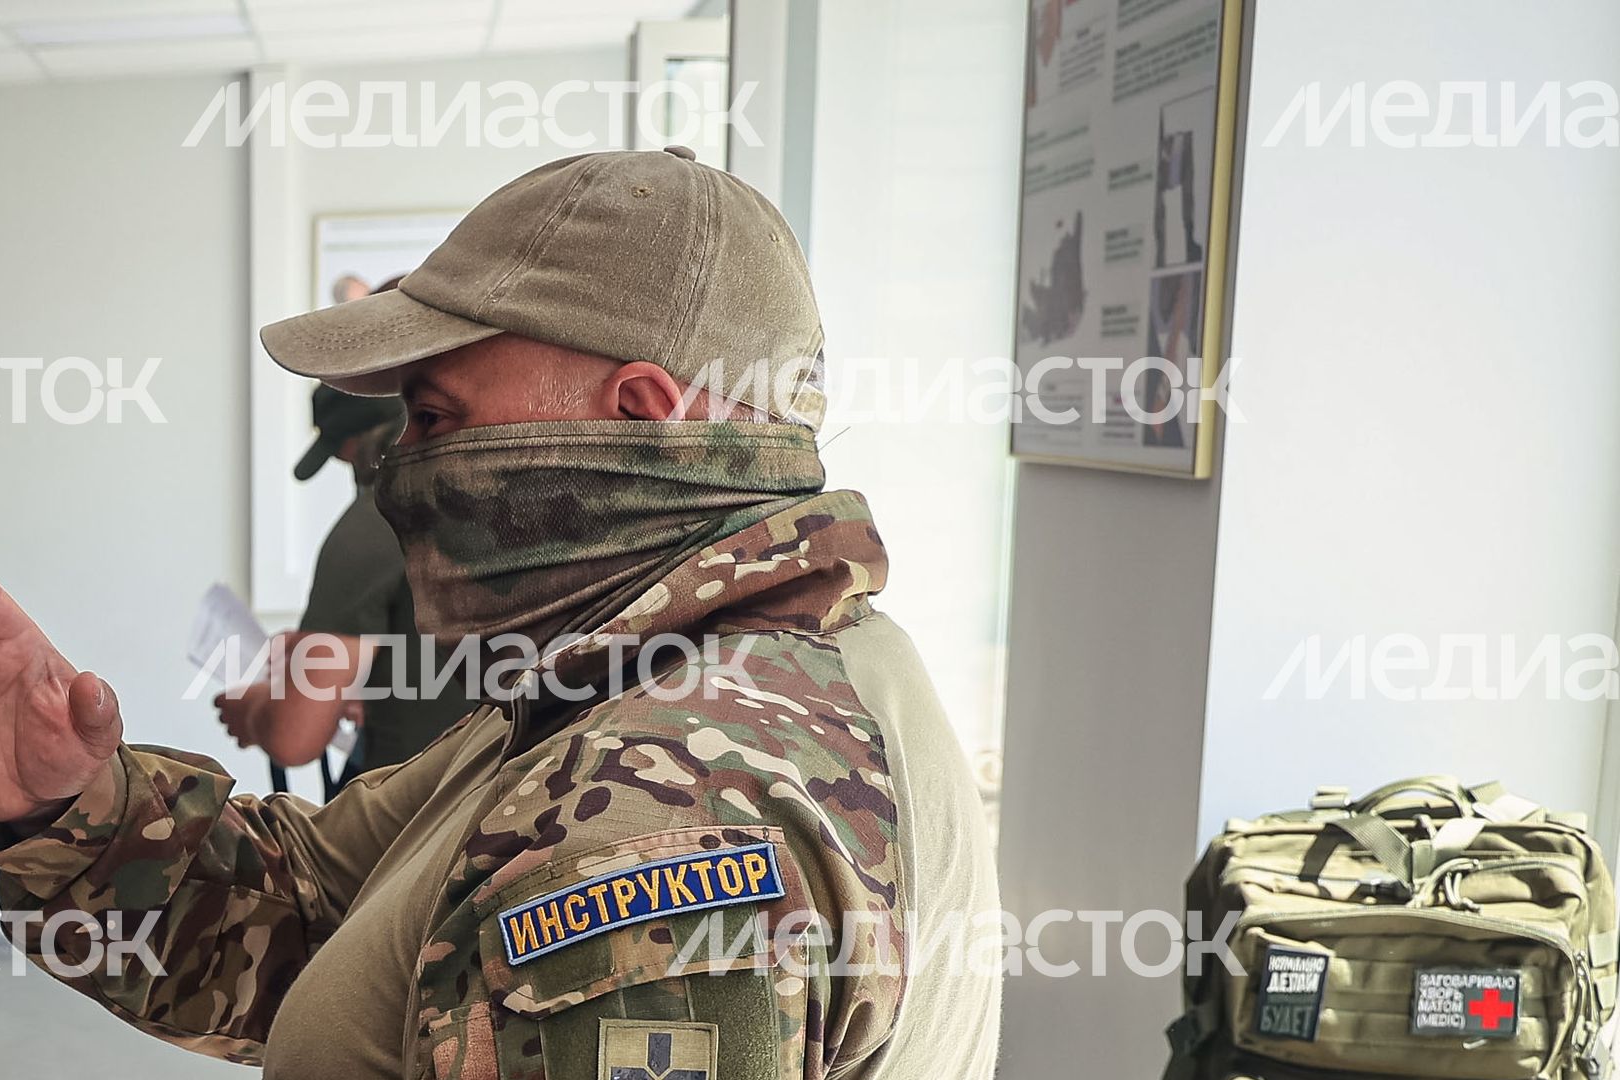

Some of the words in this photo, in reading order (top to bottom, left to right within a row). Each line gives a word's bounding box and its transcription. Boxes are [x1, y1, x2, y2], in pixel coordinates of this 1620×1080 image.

[509, 853, 768, 956] ИНСТРУКТОР
[1419, 973, 1517, 990] ЗАГОВАРИВАЮ
[1419, 986, 1464, 1001] ХВОРЬ
[1418, 999, 1463, 1013] МАТОМ
[1417, 1013, 1466, 1029] (MEDIC)
